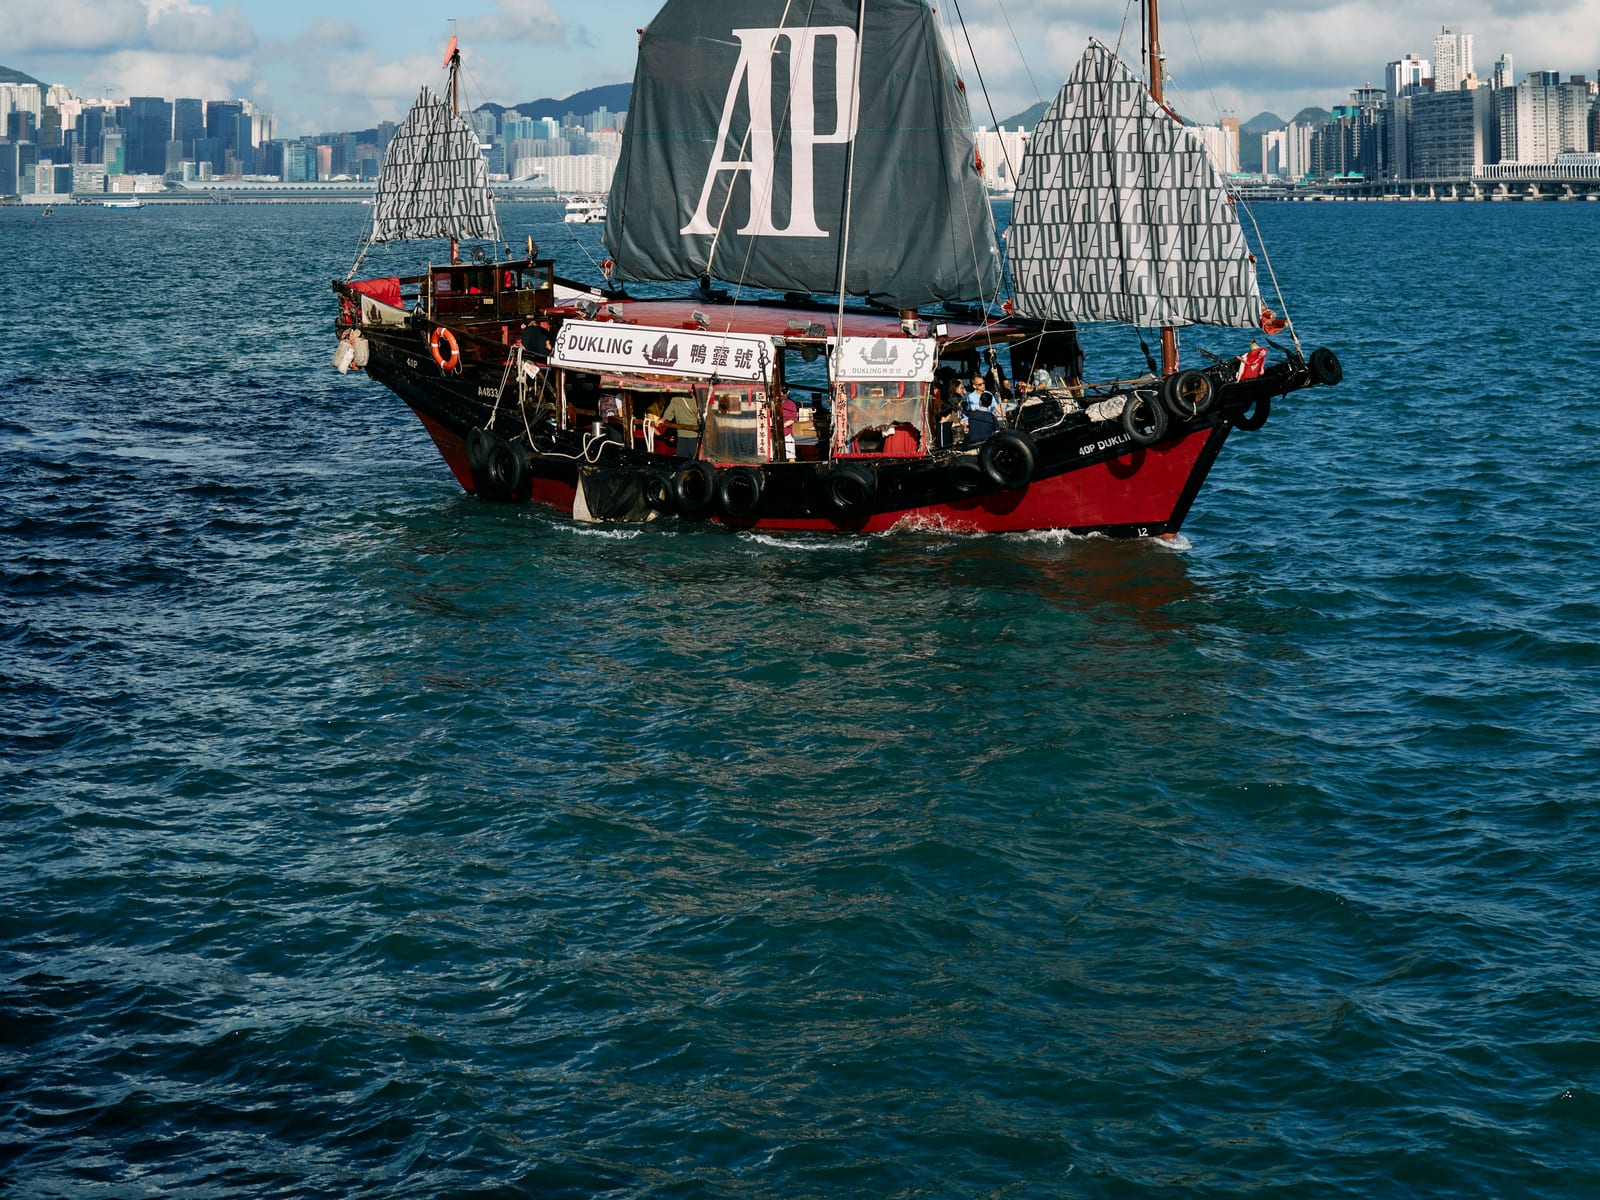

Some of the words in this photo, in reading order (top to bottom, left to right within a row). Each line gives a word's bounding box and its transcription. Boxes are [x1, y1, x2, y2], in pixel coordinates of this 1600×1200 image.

[680, 26, 859, 237] AP
[568, 334, 633, 355] DUKLING
[1079, 443, 1096, 456] 40P
